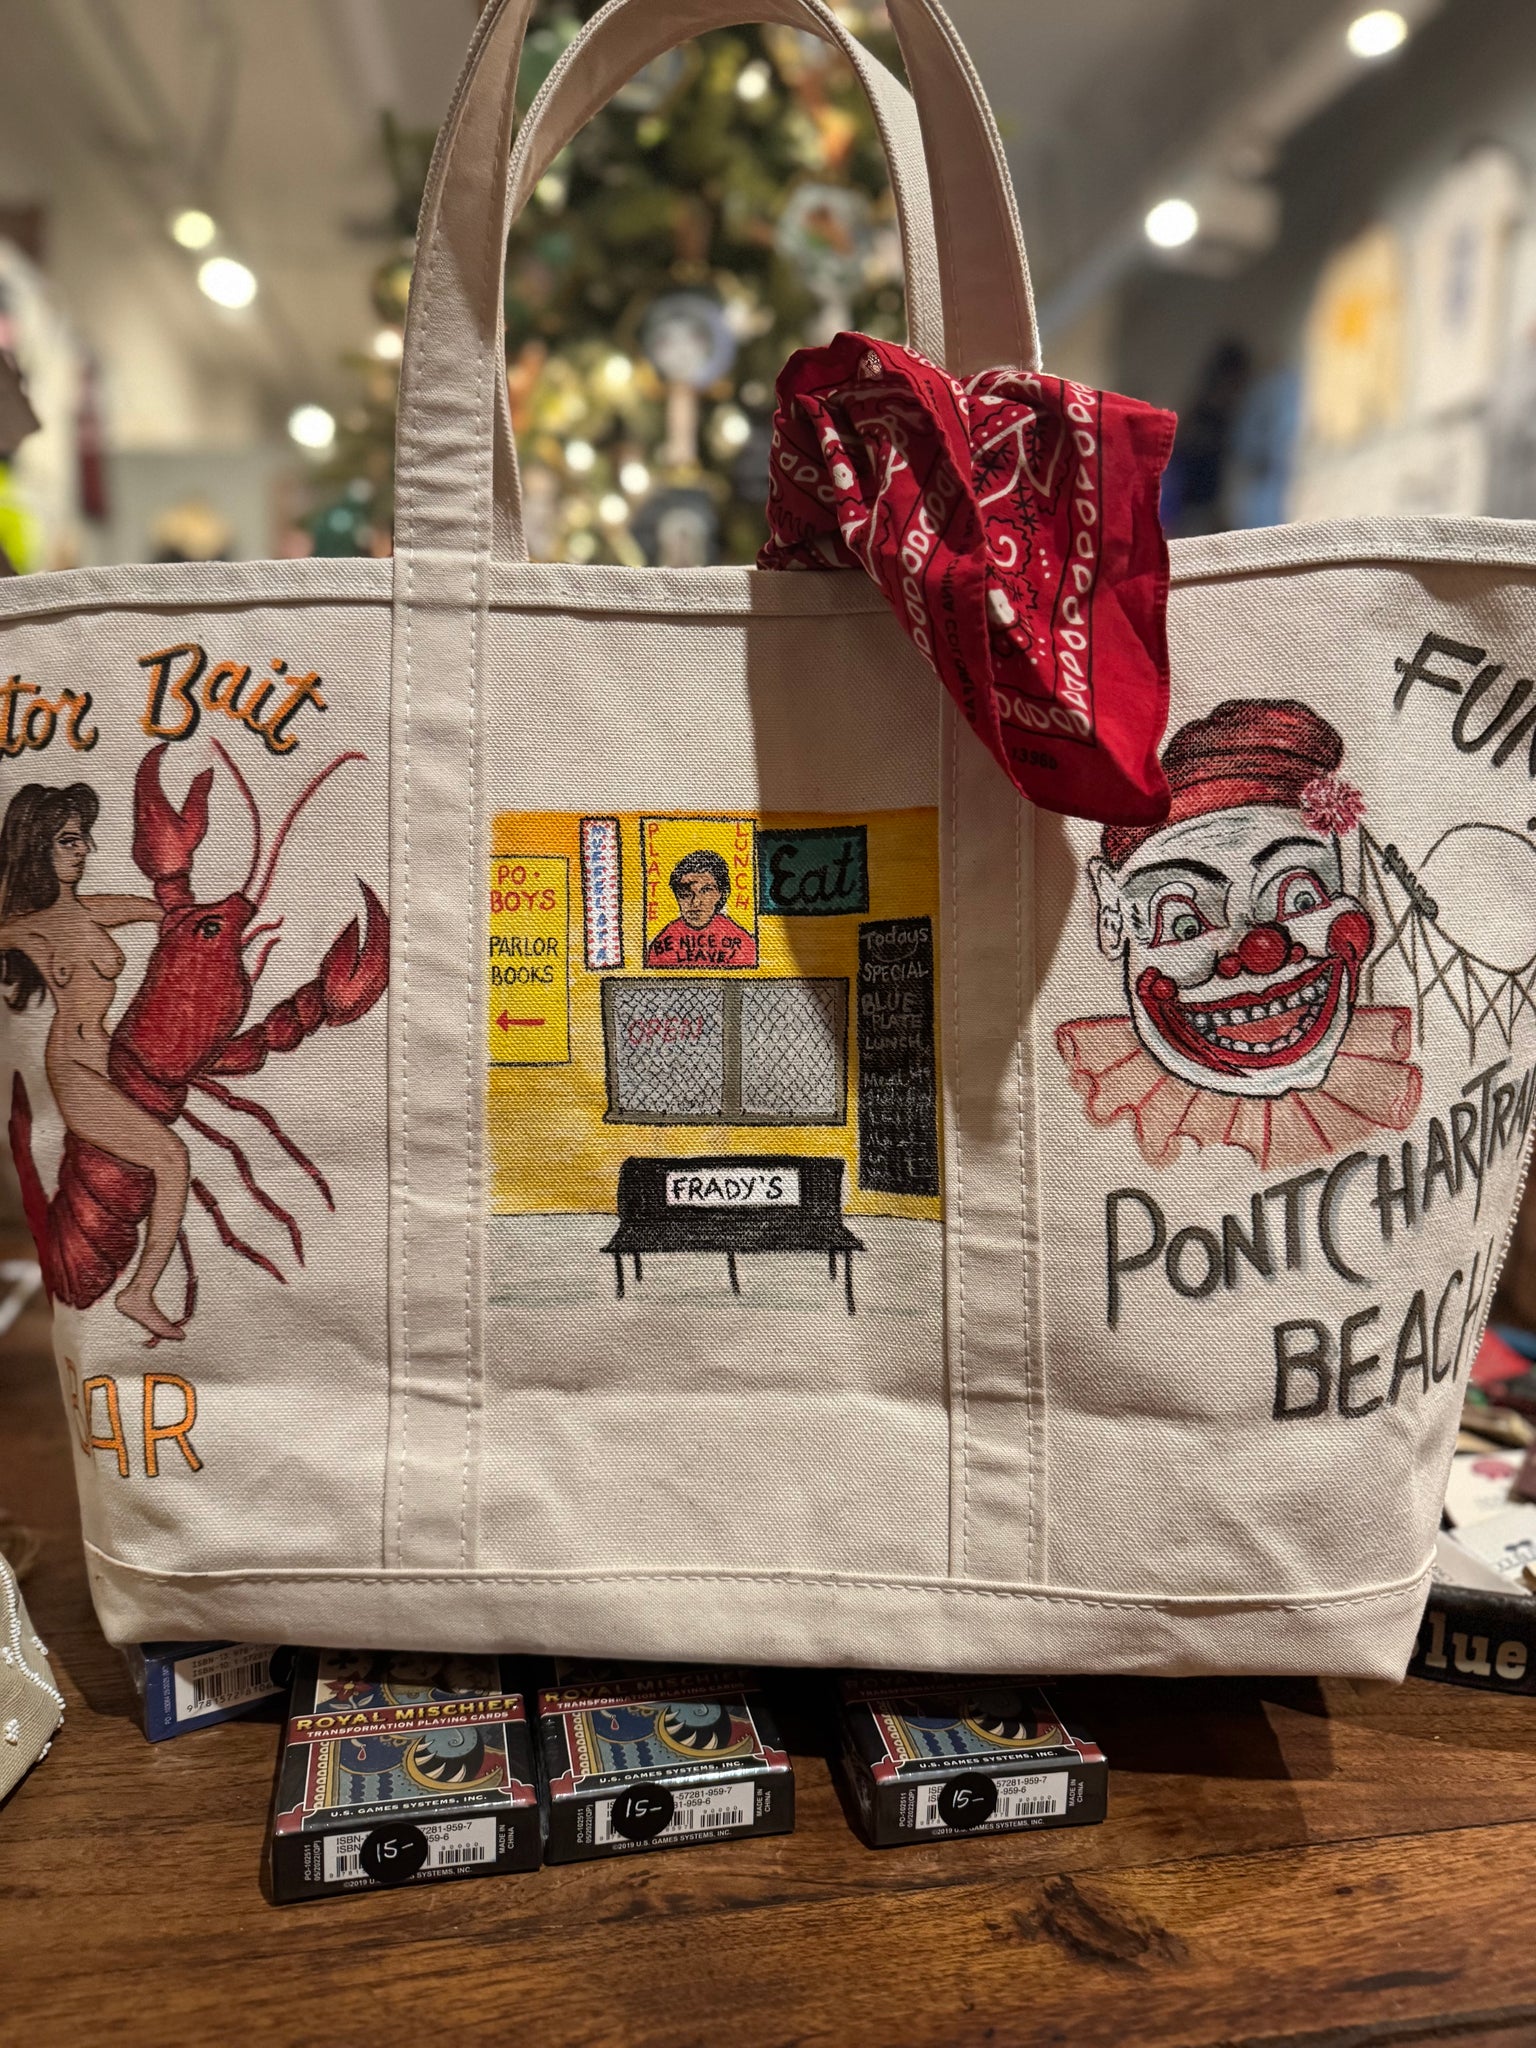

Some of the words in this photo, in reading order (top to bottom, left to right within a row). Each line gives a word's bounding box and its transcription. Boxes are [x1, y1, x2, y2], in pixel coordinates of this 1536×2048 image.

[0, 674, 99, 759] tor
[137, 642, 329, 755] Bait
[646, 822, 660, 921] PLATE
[733, 821, 750, 910] LUNCH
[768, 841, 856, 906] Eat
[489, 888, 556, 914] BOYS
[489, 935, 559, 957] PARLOR
[653, 935, 674, 956] BE
[680, 934, 717, 950] NICE
[722, 935, 742, 949] OR
[860, 925, 929, 957] Todays
[491, 965, 554, 986] BOOKS
[862, 961, 929, 983] SPECIAL
[861, 991, 918, 1016] BLUE
[628, 1016, 704, 1045] OPEN
[672, 1175, 783, 1200] FRADY'S
[1272, 1235, 1496, 1421] BEACH
[1413, 1611, 1528, 1681] lue
[544, 1685, 628, 1702] ROYAL
[296, 1711, 386, 1731] ROYAL
[395, 1698, 519, 1720] MISCHIEF
[306, 1721, 414, 1738] TRANSFORMATION
[417, 1715, 467, 1727] PLAYING
[470, 1712, 509, 1721] CARDS
[943, 1757, 980, 1766] GAMES
[982, 1753, 1034, 1763] SYSTEMS,
[624, 1770, 662, 1780] GAMES
[665, 1764, 719, 1775] SYSTEMS,
[996, 1775, 1048, 1788] 57281-959-7
[330, 1810, 354, 1818] U.S.
[357, 1804, 399, 1814] GAMES
[402, 1798, 460, 1809] SYSTEMS,
[463, 1794, 487, 1803] INC.
[420, 1821, 473, 1835] 7281-959-7
[651, 1836, 678, 1845] GAMES
[680, 1831, 716, 1841] SYSTEMS,
[336, 1835, 371, 1846] ISBN-
[416, 1868, 456, 1879] SYSTEMS,
